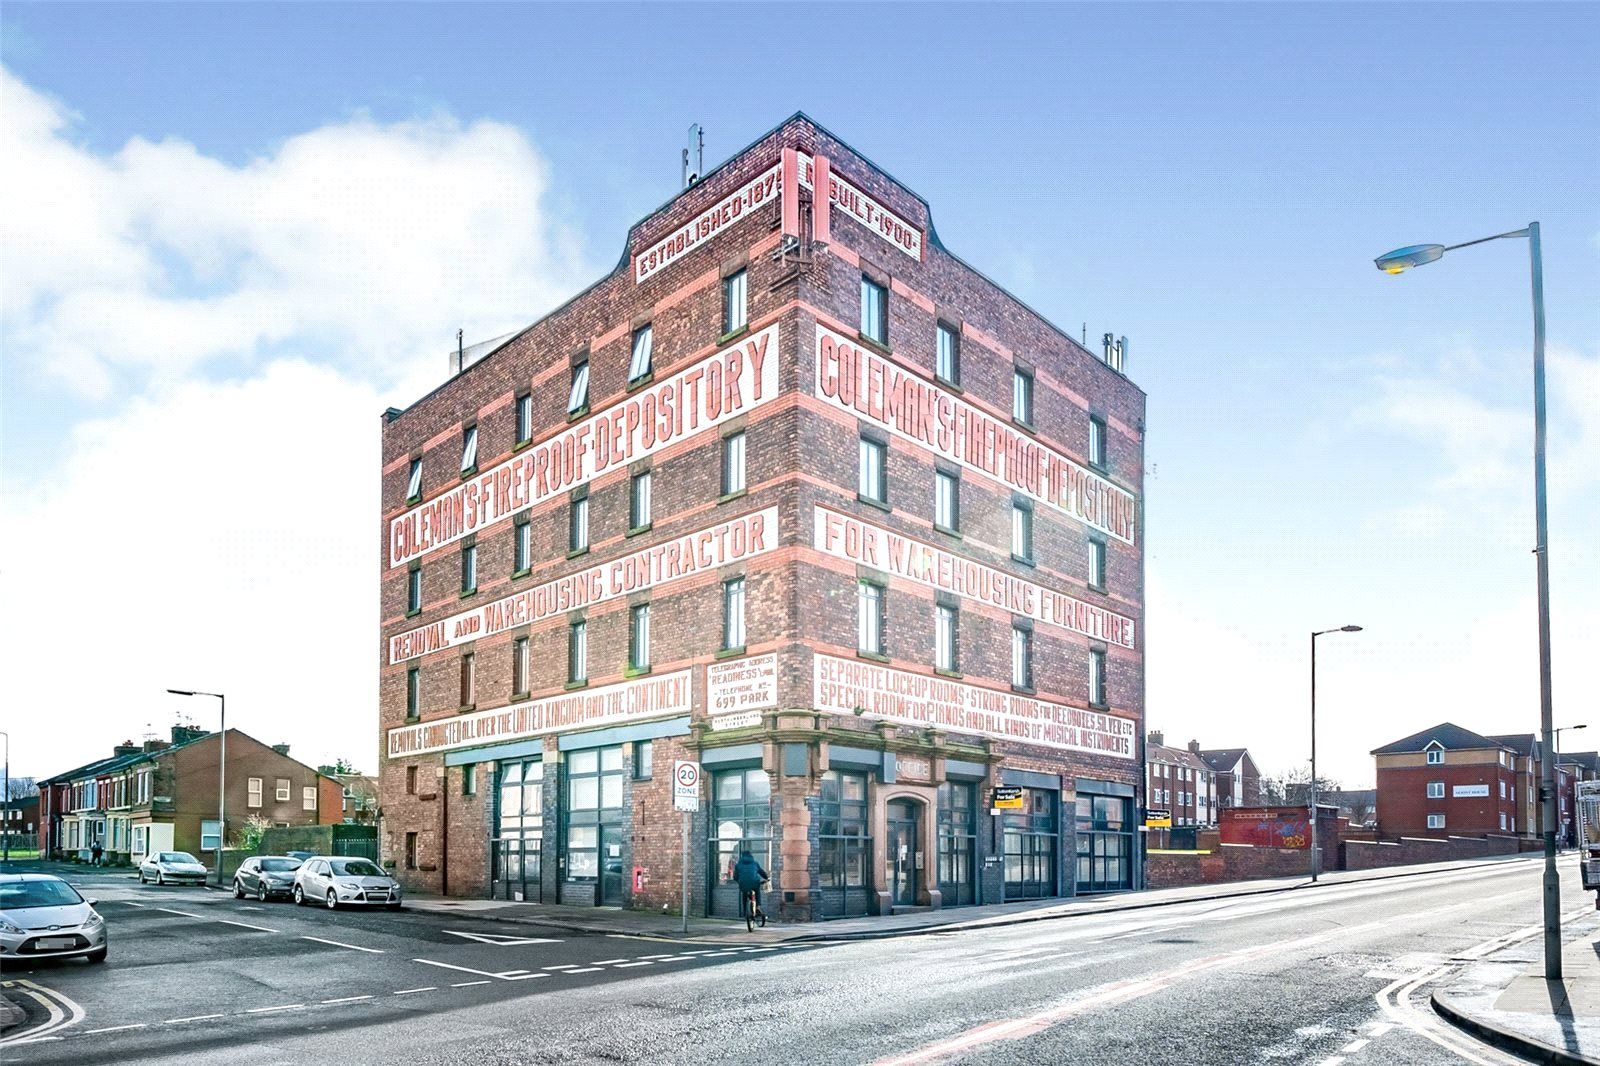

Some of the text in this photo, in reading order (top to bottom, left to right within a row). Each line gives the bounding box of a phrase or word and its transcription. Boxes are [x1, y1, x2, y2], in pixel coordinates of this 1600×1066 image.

[806, 162, 873, 224] RBUILT
[639, 200, 741, 275] ESTABLISHED
[393, 333, 770, 562] COLEMAN'S FIREPROOF DEPOSITORY
[821, 334, 1134, 540] COLEMAN'S FIREPROOF DEPOSITORY
[394, 513, 764, 661] REMOVAL AND WAREHOUSING CONTRACTOR
[826, 513, 1131, 646] FOR WAREHOUSING FURNITURE
[390, 675, 688, 754] REMOVALS CONDUCTED ALL OVER THE UNITED KINGDOM AND THE CONTINENT
[716, 691, 768, 709] 699 PARK
[820, 658, 883, 690] SEPARATE
[930, 680, 964, 705] ROOMS
[971, 689, 1007, 713] STRONG
[1010, 697, 1038, 719] ROOMS
[820, 683, 872, 712] SPECIAL
[906, 701, 926, 720] FOR
[927, 700, 964, 727] PIANOS
[966, 712, 984, 730] AND
[986, 716, 1003, 733] ALL
[1005, 718, 1030, 738] KINDS
[1032, 724, 1043, 740] OF
[1044, 723, 1078, 745] MUSICAL
[1081, 730, 1128, 754] INSTRUMENTS
[681, 770, 694, 779] 20
